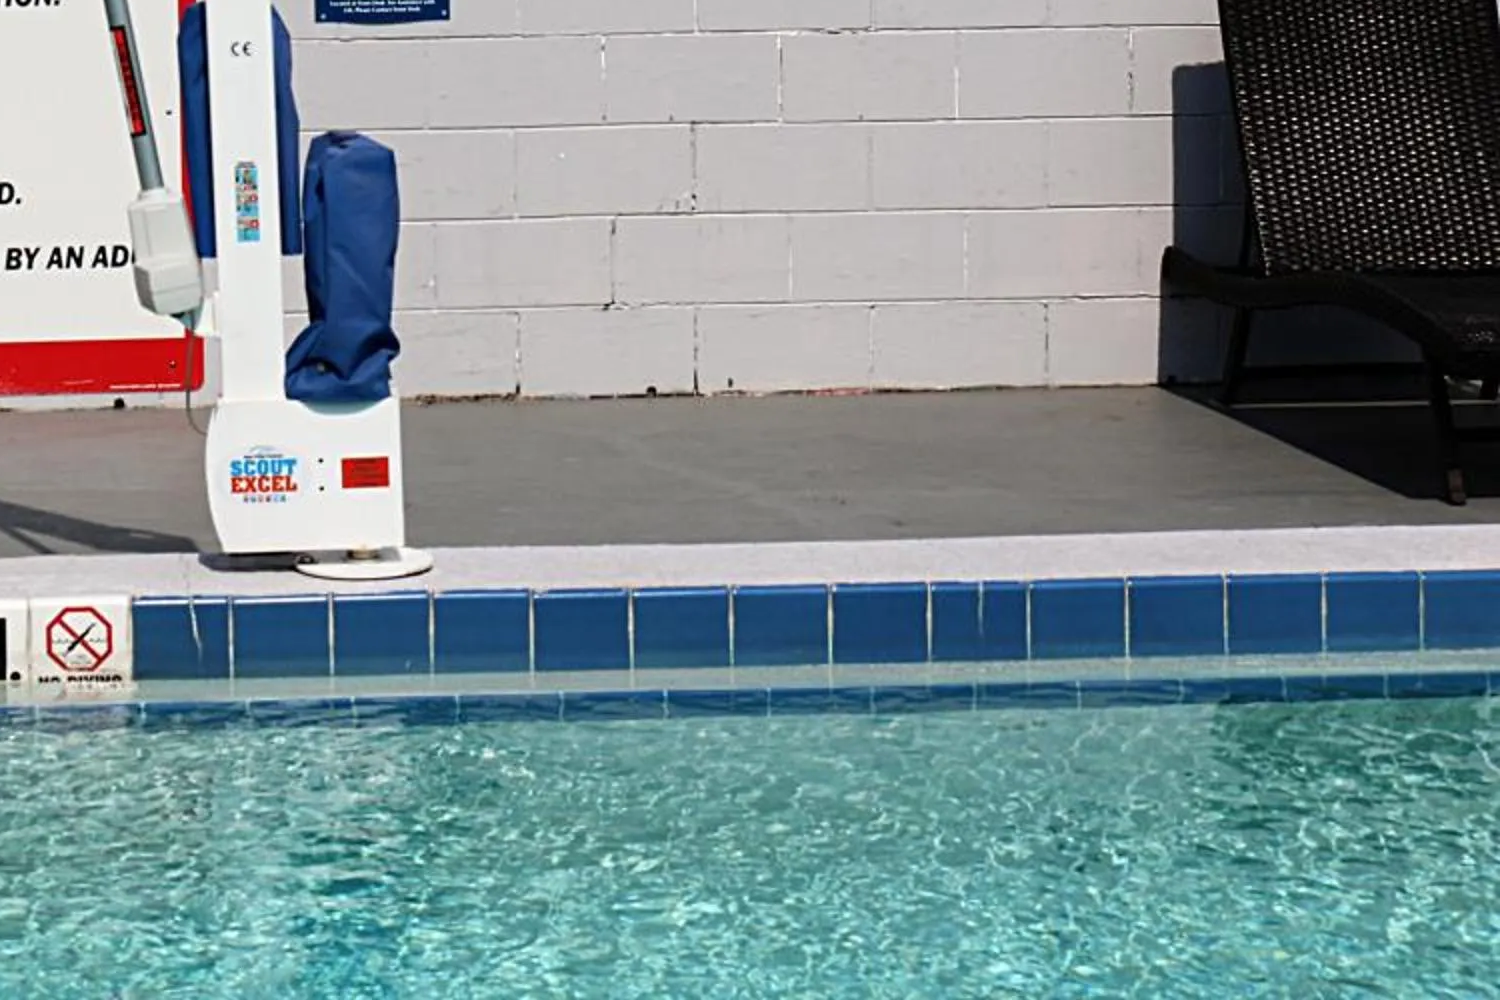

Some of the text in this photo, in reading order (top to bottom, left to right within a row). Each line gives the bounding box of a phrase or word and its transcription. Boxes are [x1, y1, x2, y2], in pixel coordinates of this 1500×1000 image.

[5, 247, 41, 271] BY
[46, 246, 85, 270] AN
[230, 458, 297, 476] SCOUT
[230, 475, 298, 493] EXCEL
